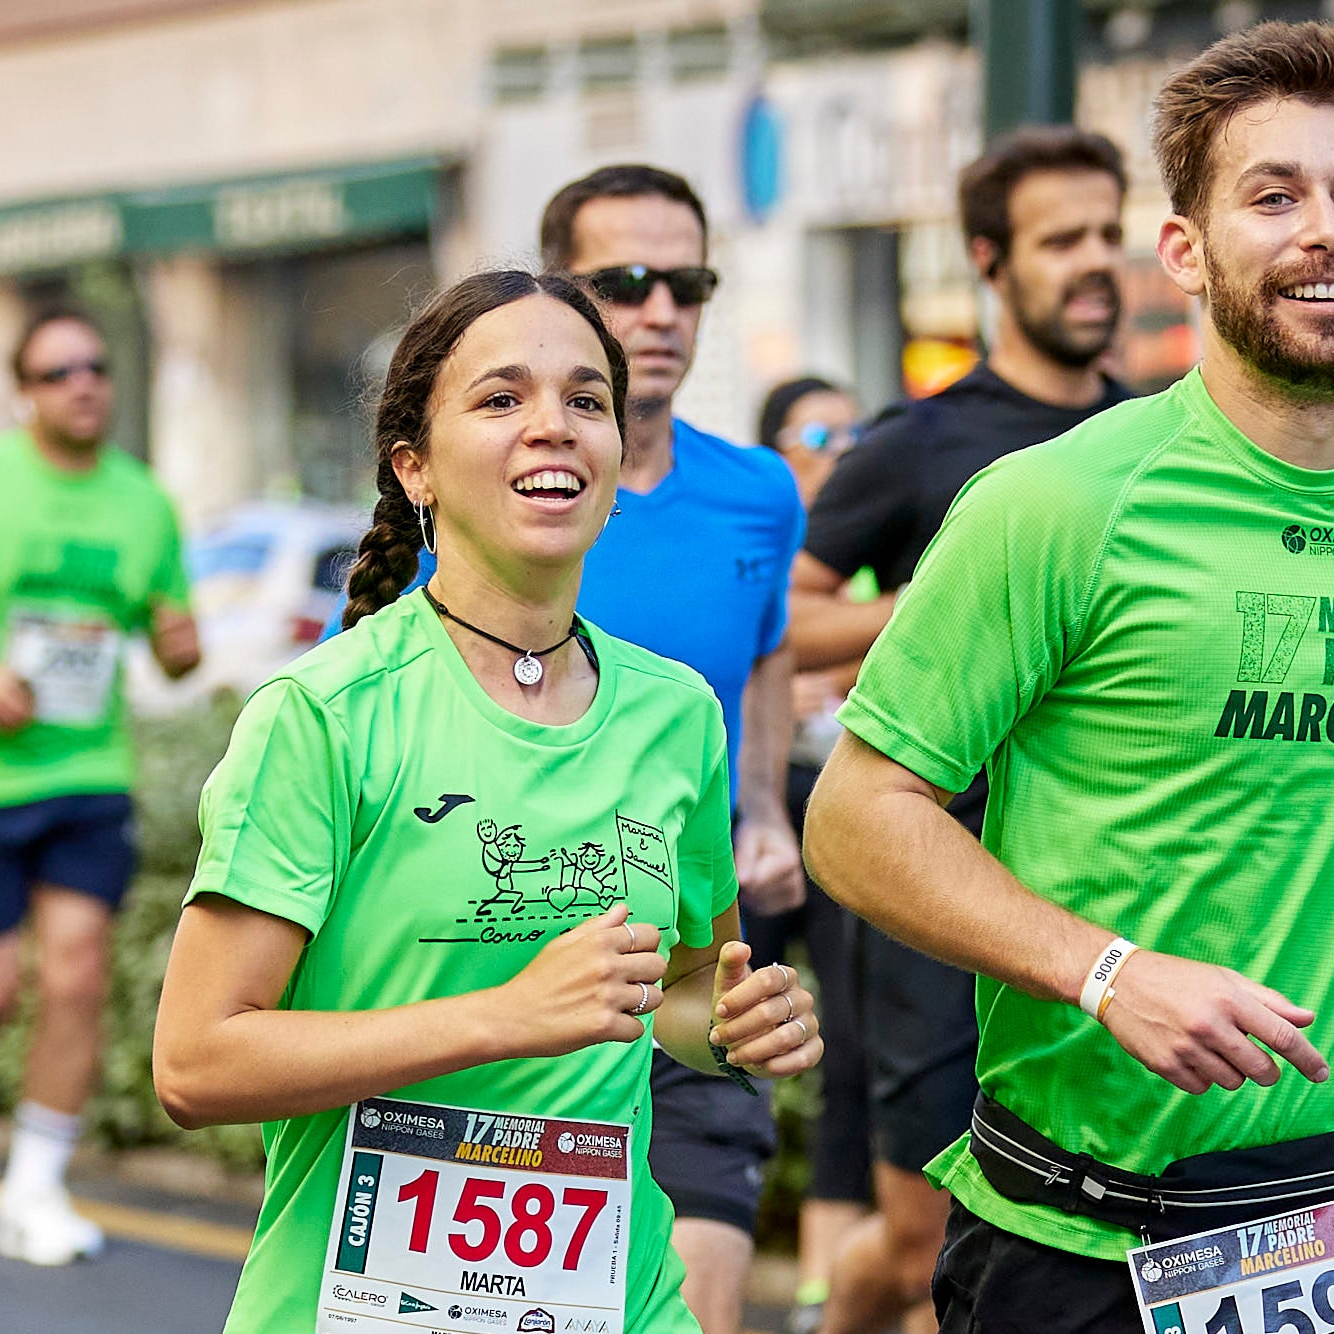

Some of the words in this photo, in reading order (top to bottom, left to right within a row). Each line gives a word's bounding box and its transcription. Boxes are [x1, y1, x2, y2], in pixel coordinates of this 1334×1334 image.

[1235, 590, 1318, 685] 17
[625, 846, 669, 878] Samuel
[480, 926, 546, 943] Corro
[381, 1122, 414, 1136] NIPPON
[415, 1127, 445, 1140] GASES
[382, 1110, 445, 1131] OXIMESA
[464, 1113, 496, 1144] 17
[494, 1115, 546, 1134] MEMORIAL
[491, 1129, 541, 1151] PADRE
[576, 1132, 623, 1150] OXIMESA
[455, 1142, 544, 1168] MARCELINO
[575, 1146, 602, 1158] NIPPON
[602, 1149, 623, 1160] GASES
[357, 1174, 375, 1187] 3
[348, 1191, 373, 1247] CAJÓN
[397, 1169, 609, 1272] 1587
[1265, 1211, 1316, 1236] MEMORIAL
[1236, 1223, 1267, 1259] 17
[1267, 1224, 1316, 1251] PADRE
[1161, 1245, 1223, 1269] OXIMESA
[1164, 1264, 1197, 1279] NIPPON
[1197, 1257, 1225, 1271] GASES
[1240, 1239, 1326, 1276] MARCELINO
[609, 1255, 617, 1284] PRUEBA
[335, 1287, 388, 1305] CALERO
[460, 1271, 527, 1297] MARTA
[464, 1306, 508, 1319] OXIMESA
